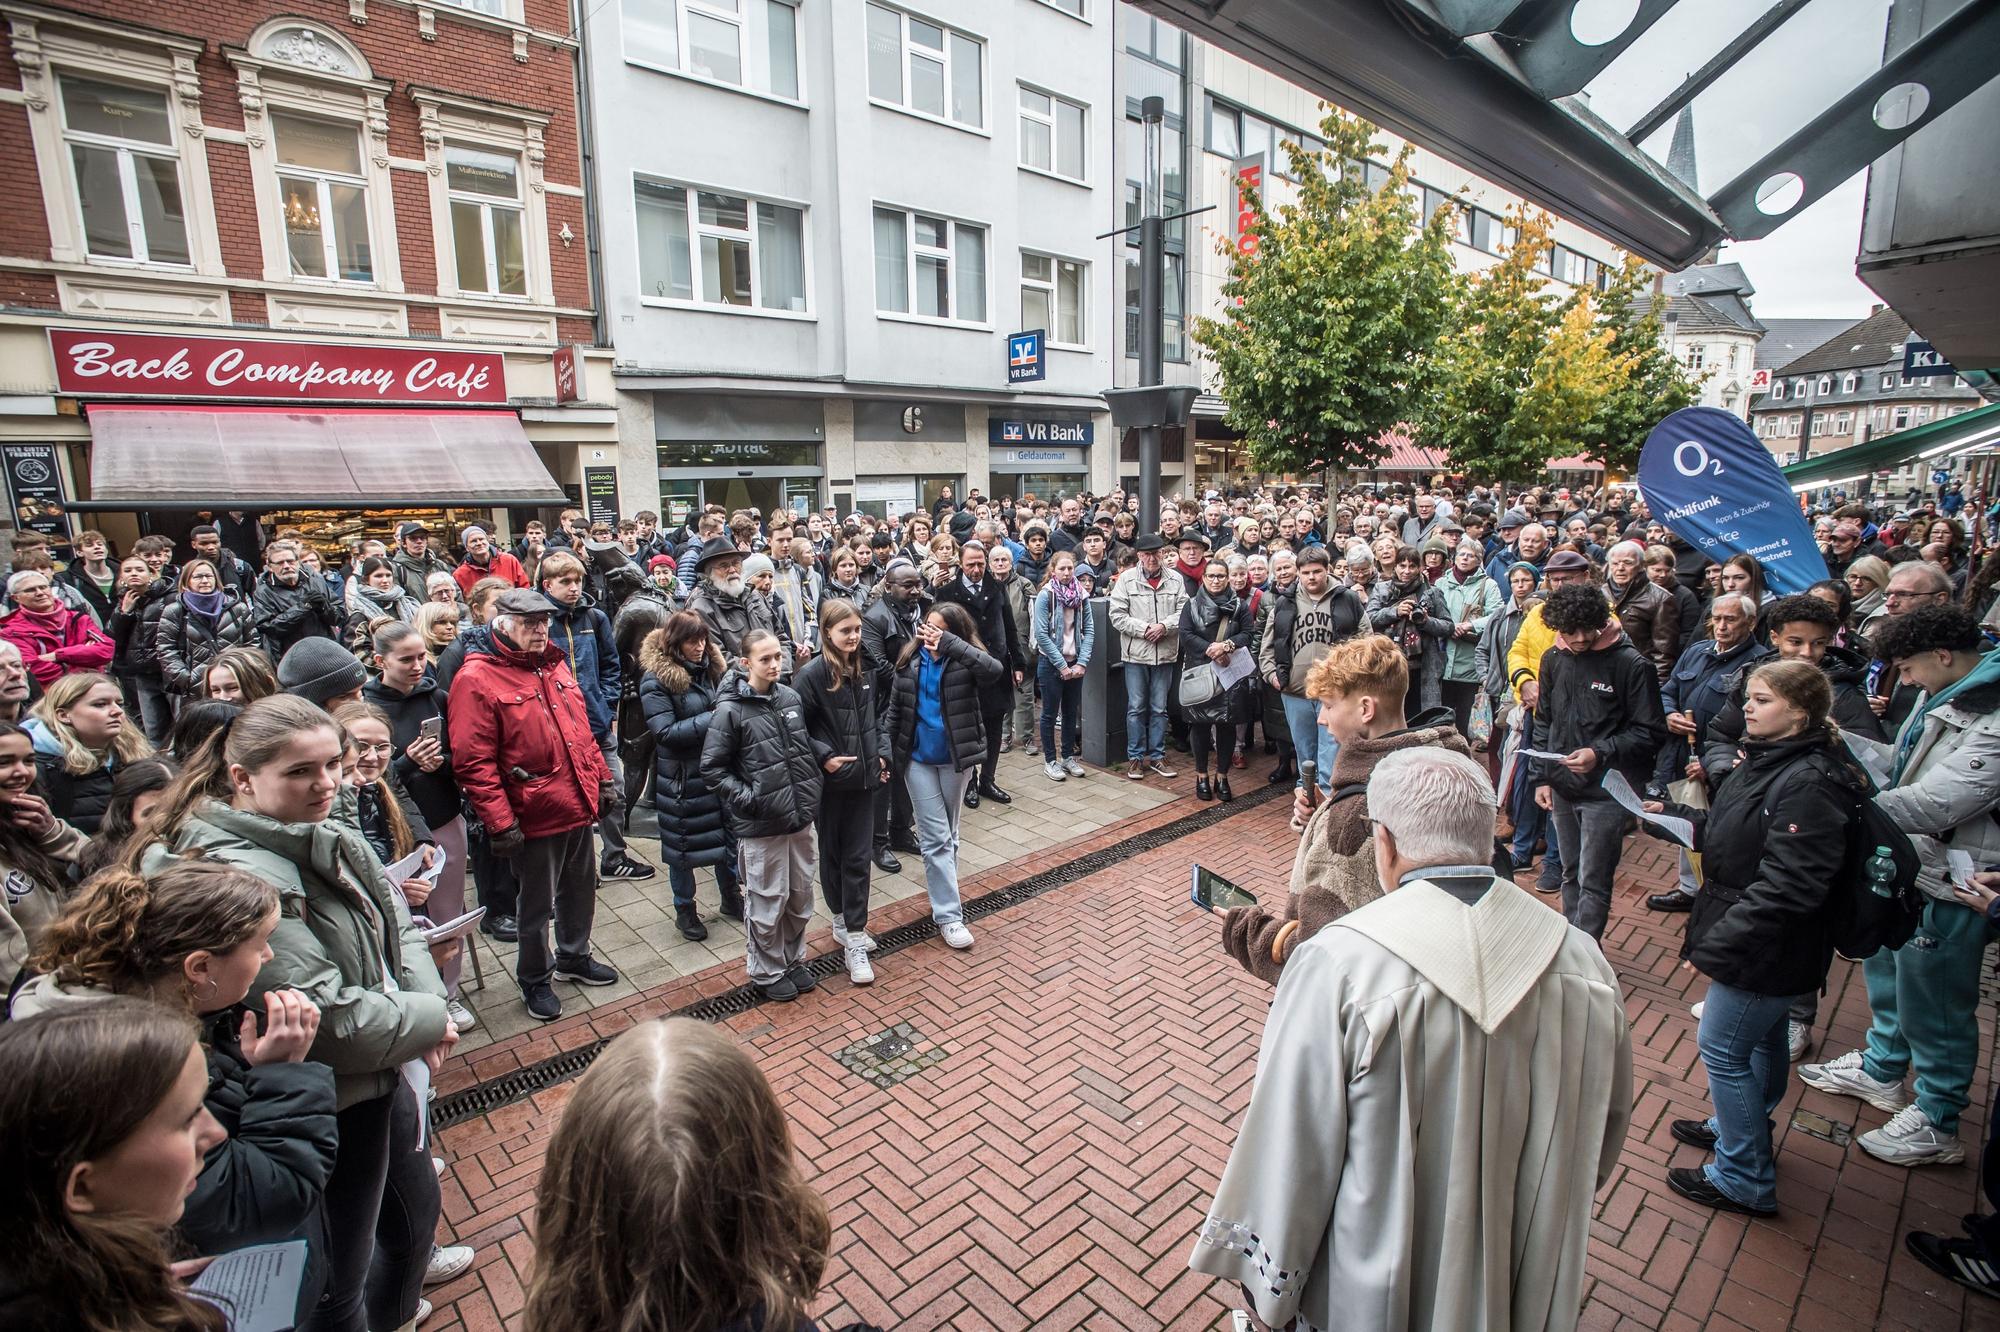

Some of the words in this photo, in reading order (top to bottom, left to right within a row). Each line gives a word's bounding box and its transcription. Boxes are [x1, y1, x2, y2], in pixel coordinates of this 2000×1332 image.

[68, 341, 194, 381] Back
[205, 347, 395, 395] Company
[404, 357, 490, 398] Café
[1010, 368, 1021, 379] VR
[1021, 366, 1038, 377] Bank
[1027, 423, 1047, 440] VR
[1050, 423, 1085, 441] Bank
[1018, 450, 1066, 461] Geldautomat
[1673, 440, 1725, 477] O2
[1663, 495, 1721, 522] Mobilfunk
[1715, 514, 1733, 525] Apps
[1733, 510, 1740, 518] &
[1740, 500, 1771, 516] Zubehör
[1746, 540, 1781, 555] Internet
[1781, 538, 1789, 546] &
[1295, 611, 1332, 632] LOW
[1292, 627, 1335, 658] LIGHT
[1591, 681, 1614, 693] FILA
